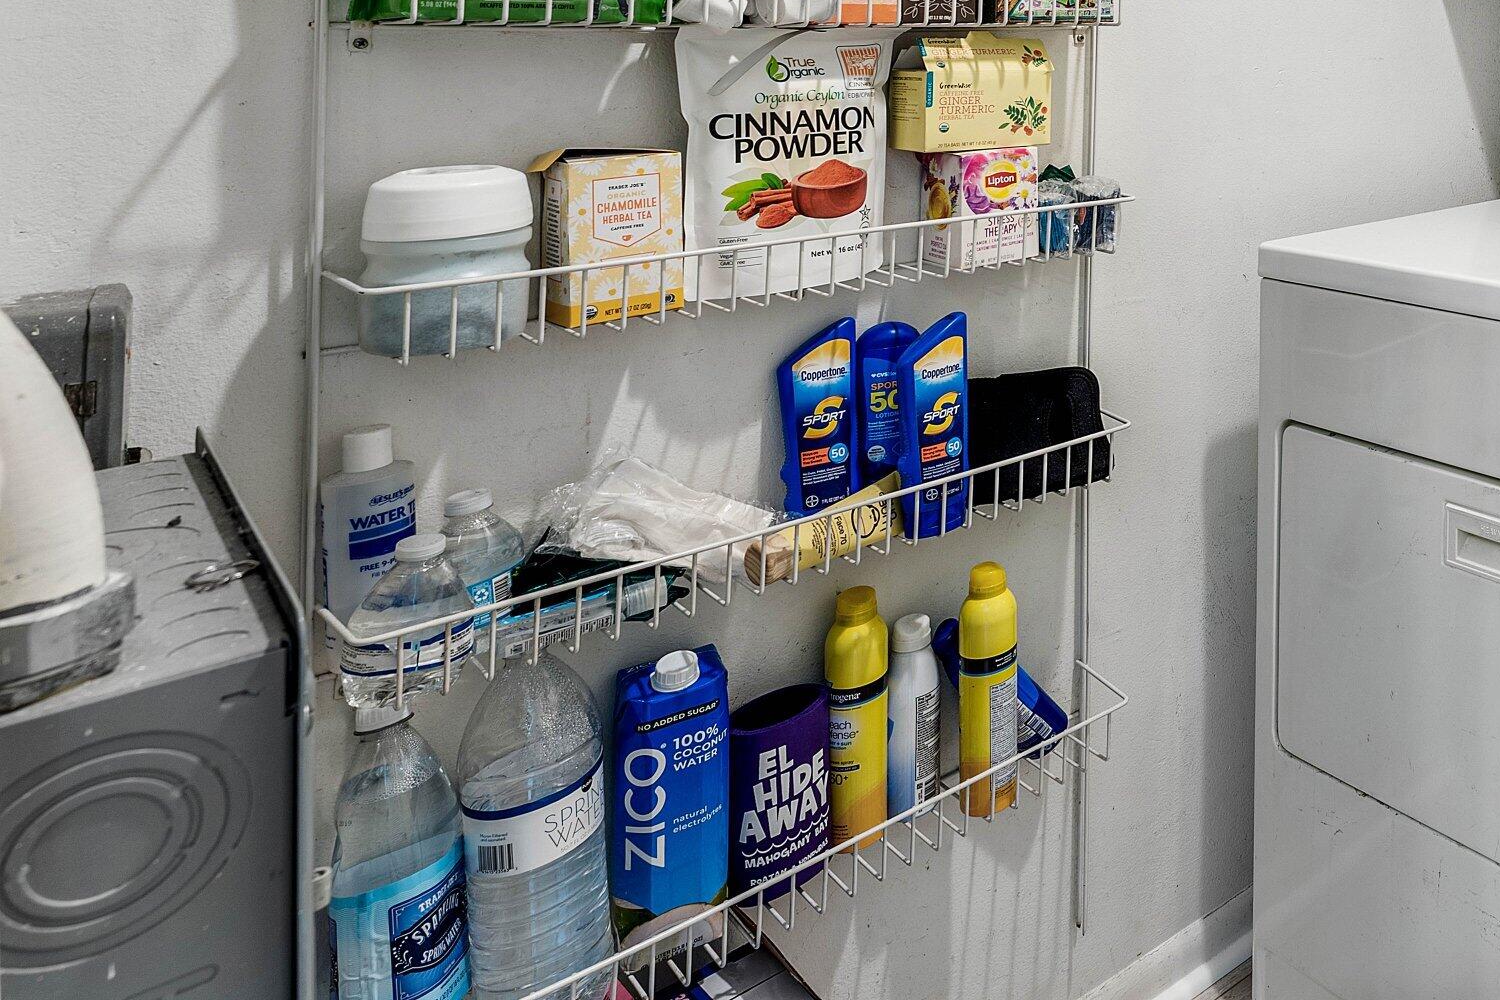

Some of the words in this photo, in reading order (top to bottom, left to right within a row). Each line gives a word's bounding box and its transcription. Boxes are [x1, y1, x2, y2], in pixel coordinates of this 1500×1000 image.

[784, 57, 816, 67] True
[768, 62, 825, 82] Organic
[754, 90, 804, 109] Organic
[806, 86, 845, 107] Ceylon
[939, 96, 981, 105] GINGER
[939, 105, 995, 114] TURMERIC
[709, 106, 874, 140] CINNAMON
[735, 130, 864, 163] POWDER
[987, 175, 1014, 185] Lipton
[607, 190, 646, 200] ORGANIC
[597, 197, 657, 214] CHAMOMILE
[603, 213, 634, 224] HERBAL
[637, 211, 652, 220] TEA
[801, 366, 846, 381] Coppertone
[922, 363, 960, 379] Coppertone
[803, 410, 846, 426] SPORT
[923, 404, 960, 423] SPORT
[832, 448, 845, 458] 50
[948, 442, 959, 452] 50
[350, 506, 406, 530] WATER
[835, 516, 844, 534] Face
[360, 562, 379, 572] FREE
[638, 724, 650, 732] NO
[653, 712, 685, 728] ADDED
[687, 702, 716, 717] SUGAR
[672, 724, 718, 750] 100%
[673, 728, 727, 760] COCONUT
[673, 748, 718, 771] WATER
[759, 745, 794, 780] EL
[753, 748, 824, 812] HIDE
[624, 748, 666, 871] ZICO
[672, 806, 708, 824] natural
[739, 770, 829, 844] AWAY
[672, 804, 723, 833] electrolytes
[744, 833, 811, 868] MAHOGANY
[814, 817, 829, 836] BAY
[420, 941, 446, 964] SPRING
[445, 918, 462, 952] WATER
